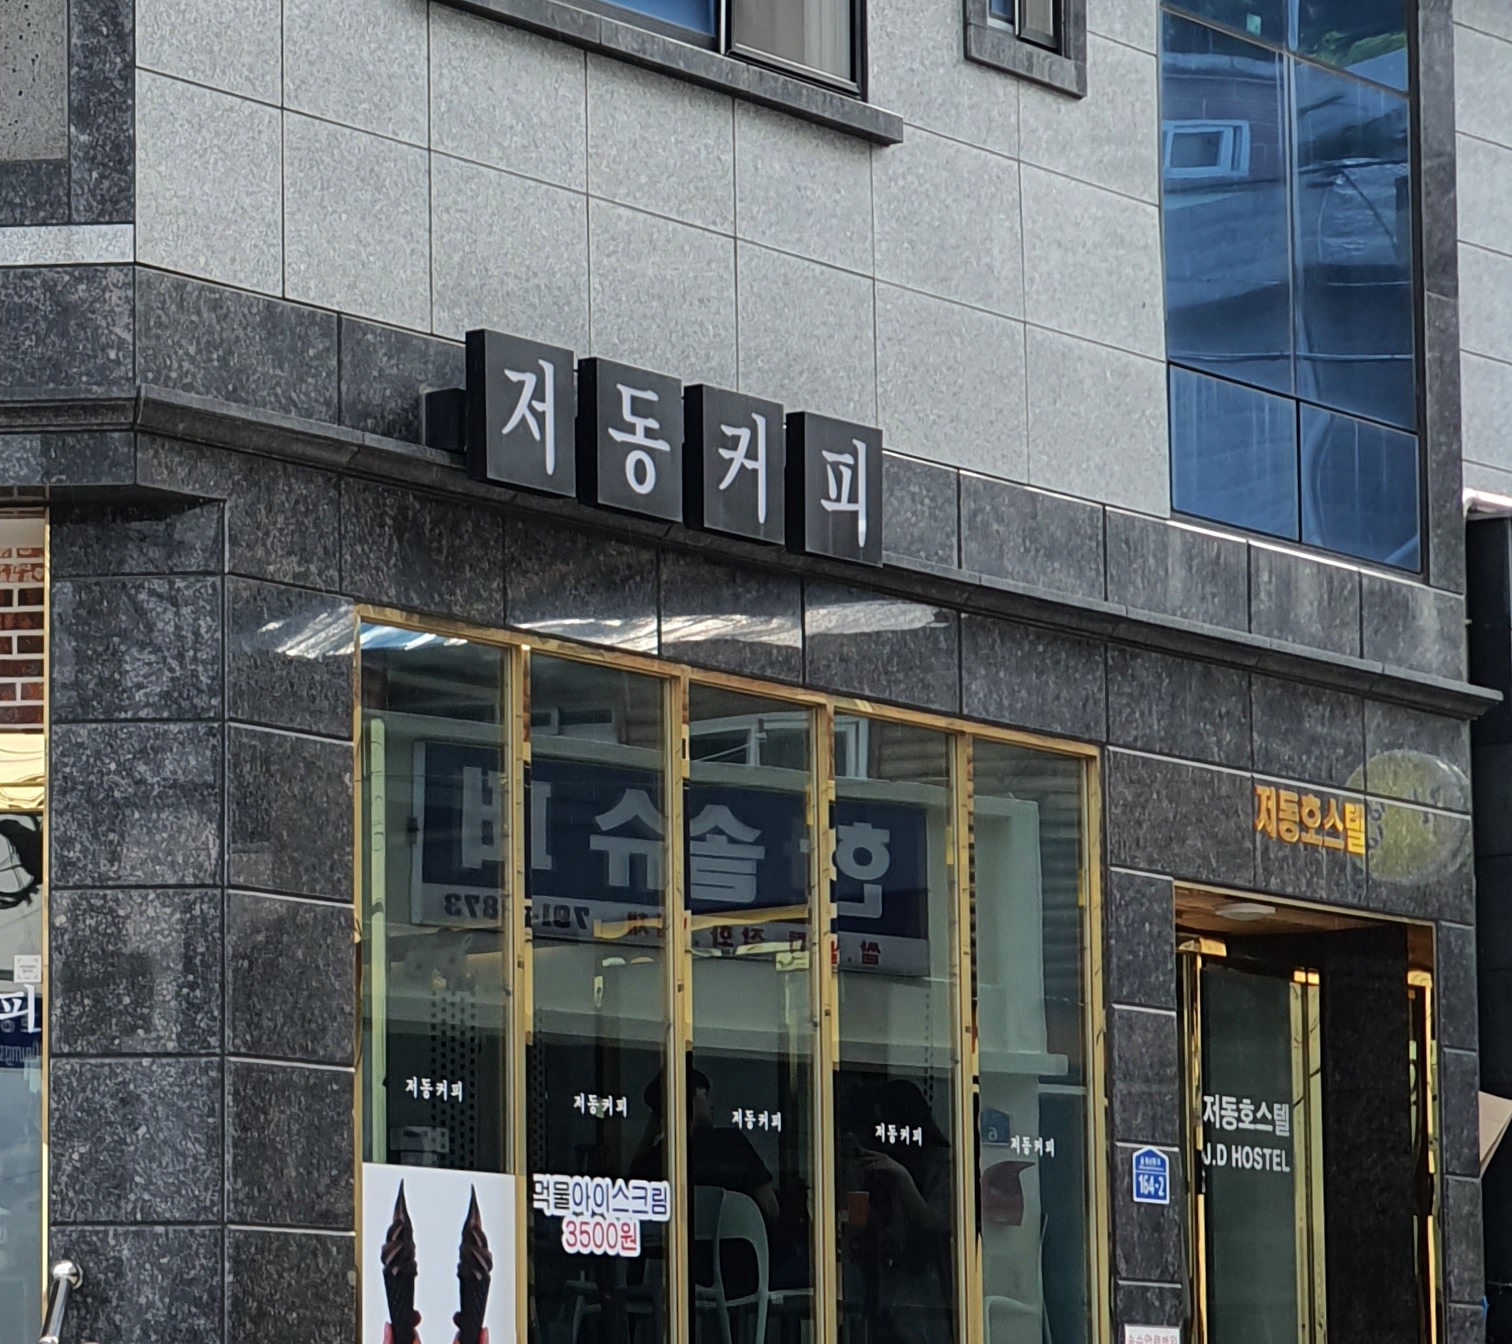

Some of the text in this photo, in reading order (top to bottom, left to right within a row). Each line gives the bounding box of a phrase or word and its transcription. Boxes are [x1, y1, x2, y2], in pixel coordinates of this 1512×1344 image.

[502, 359, 867, 548] 저동커피
[1255, 784, 1366, 855] 저동호스텔
[406, 1076, 464, 1103] 저동커피
[573, 1092, 628, 1118] 저동커피
[731, 1108, 782, 1132] 저동커피
[1203, 1094, 1290, 1137] 저동호스텔
[874, 1123, 923, 1148] 저동커피
[1010, 1134, 1055, 1158] 저동커피
[1202, 1142, 1291, 1173] J.D HOSTEL
[533, 1179, 667, 1215] 먹물아이스크림
[565, 1220, 637, 1251] 3500원
